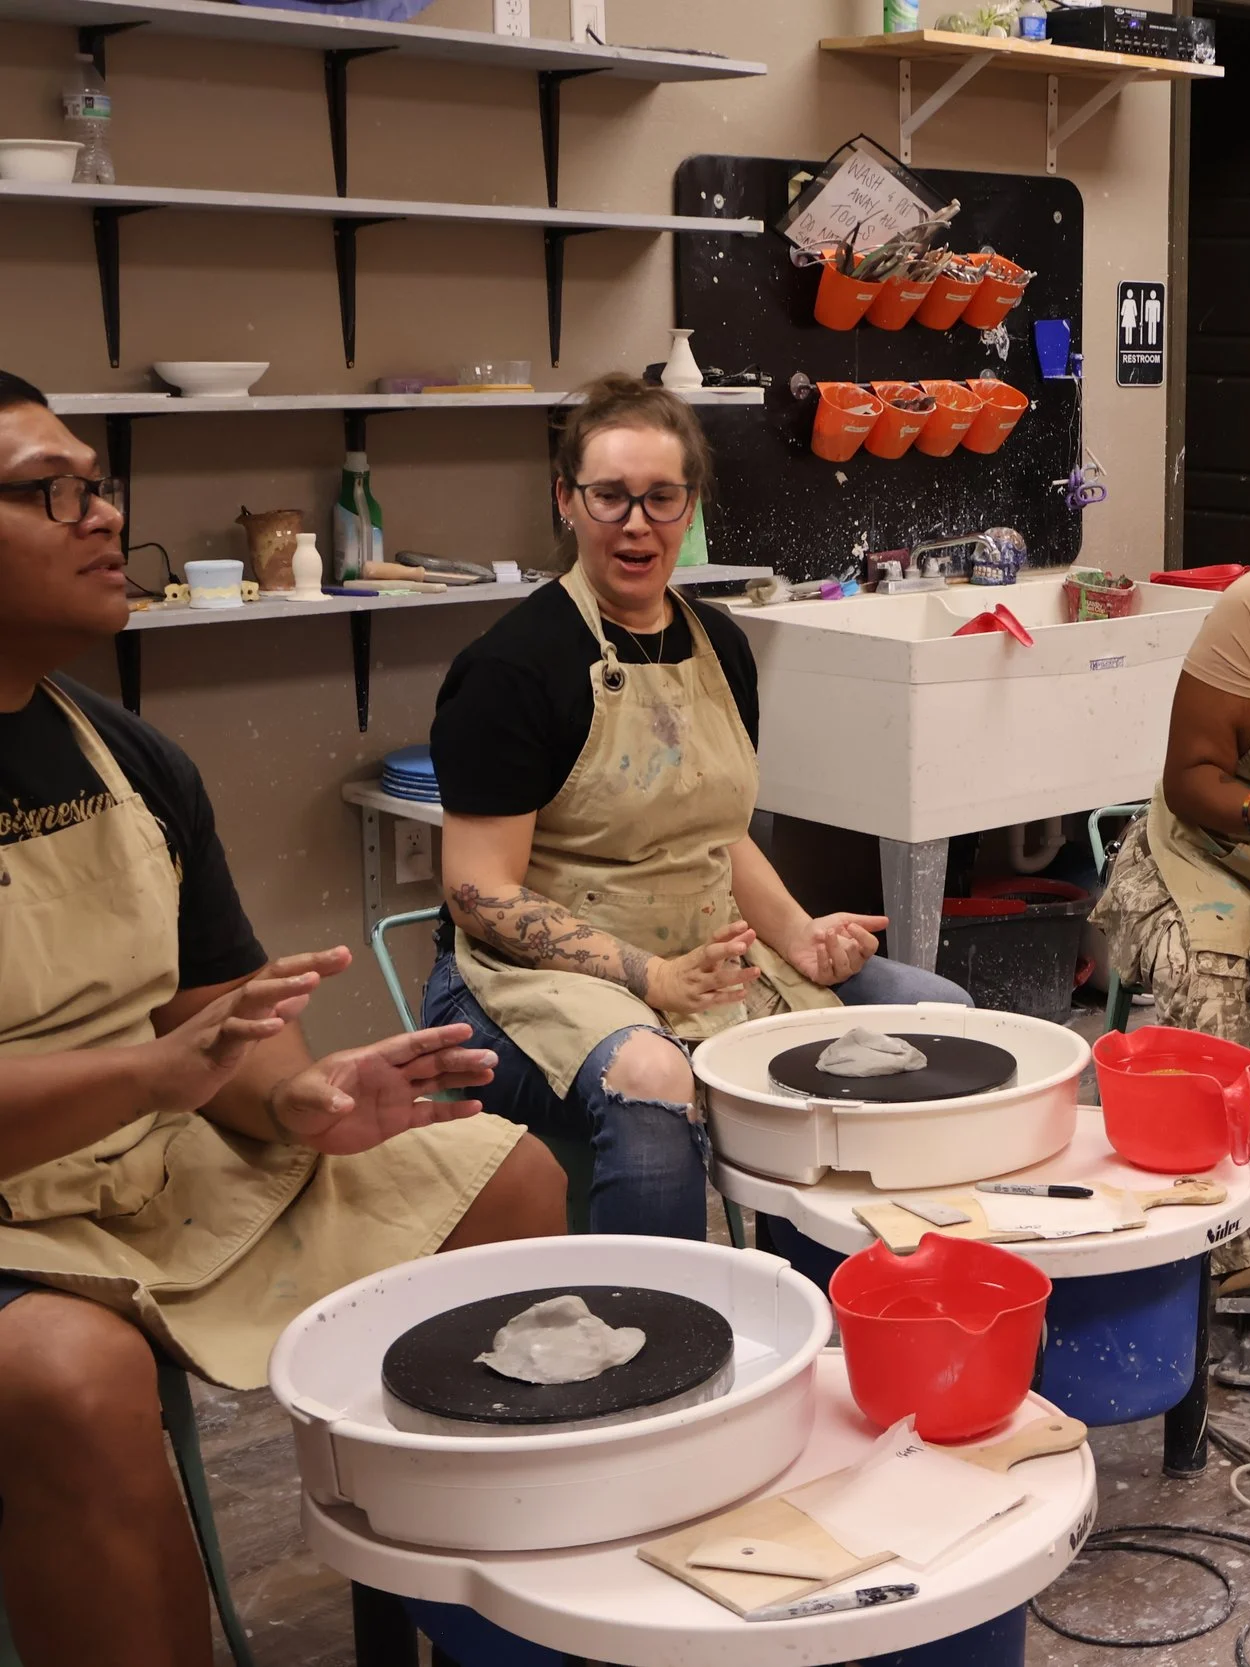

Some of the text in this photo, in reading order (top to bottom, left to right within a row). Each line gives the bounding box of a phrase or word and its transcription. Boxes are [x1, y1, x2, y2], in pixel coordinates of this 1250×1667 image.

[847, 188, 880, 214] AWAY
[848, 158, 885, 192] WASH
[895, 197, 915, 217] PUT
[831, 204, 876, 240] TOOS
[1122, 354, 1161, 364] RESTROOM
